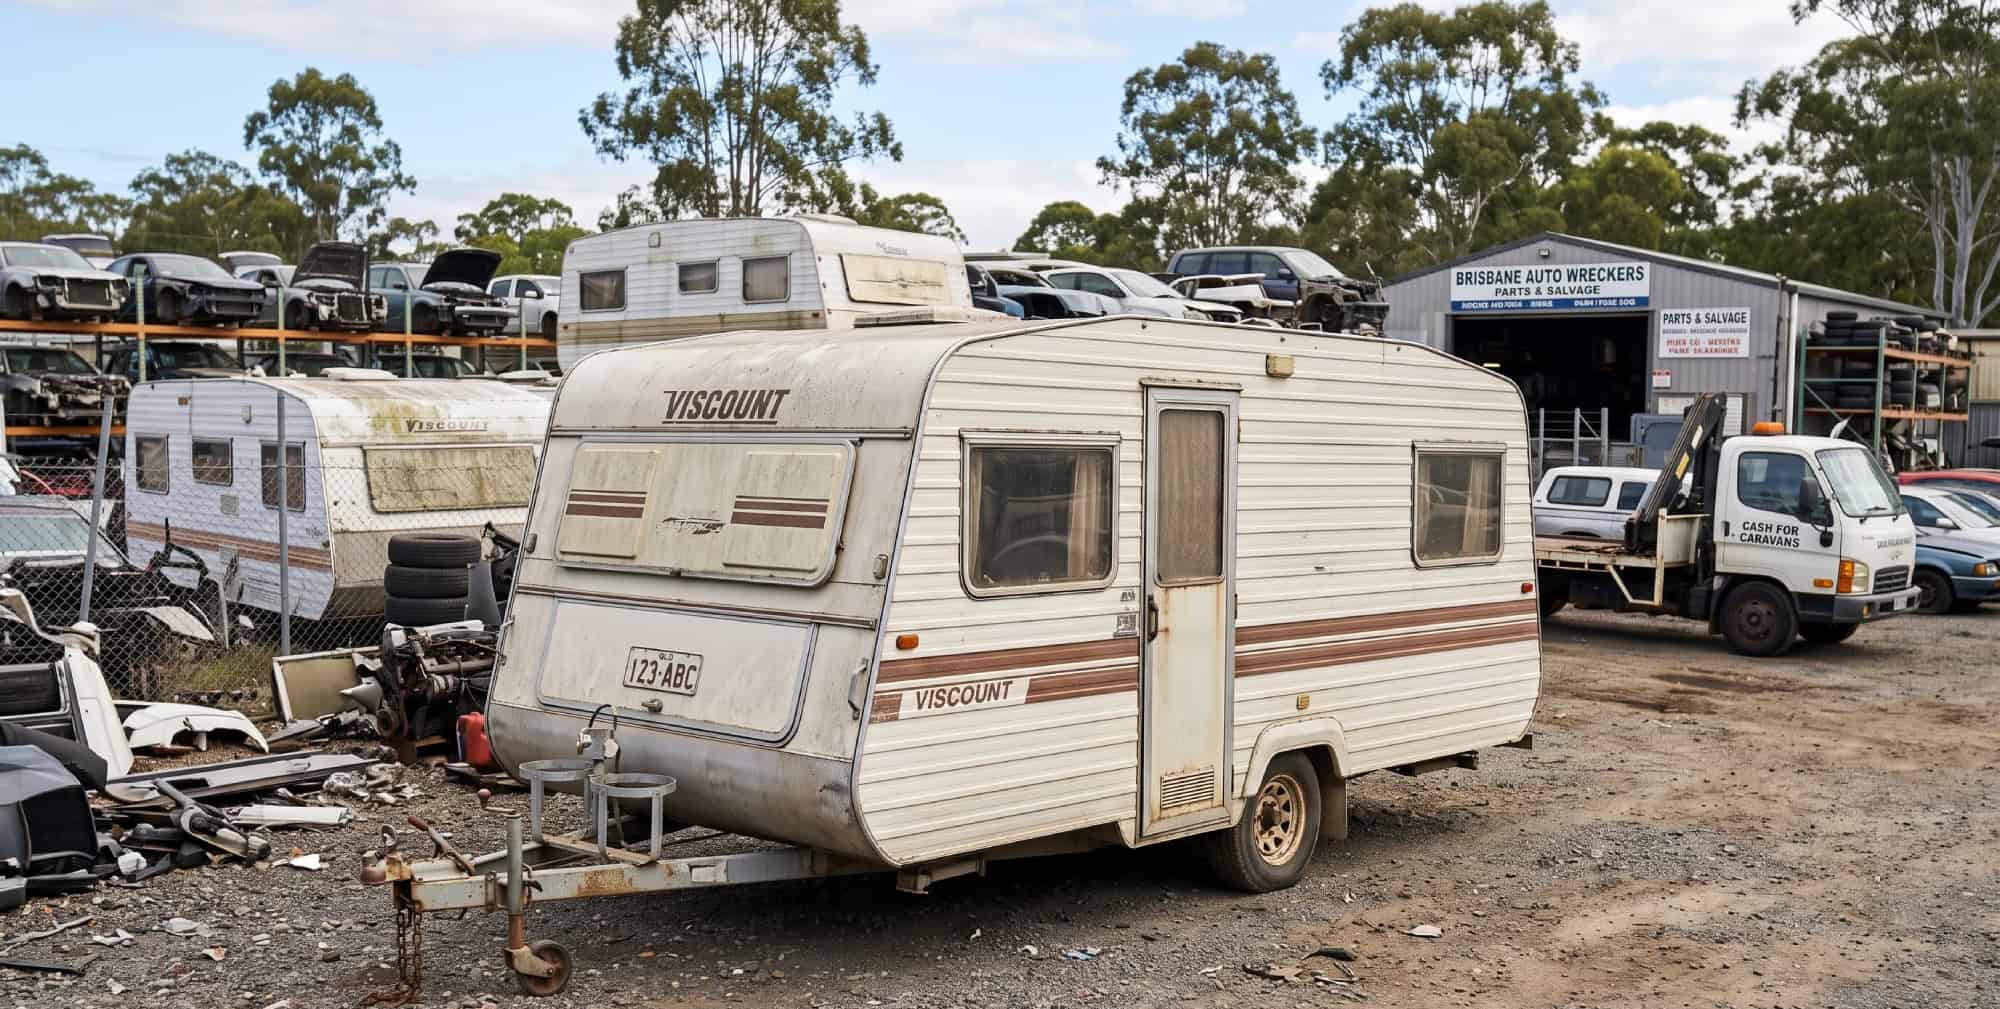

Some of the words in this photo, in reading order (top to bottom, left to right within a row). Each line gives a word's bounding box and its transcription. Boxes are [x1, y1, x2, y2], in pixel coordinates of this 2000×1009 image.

[1456, 270, 1521, 286] BRISBANE
[1526, 269, 1562, 284] AUTO
[1566, 265, 1645, 283] WRECKERS
[1495, 287, 1531, 297] PARTS
[1535, 286, 1543, 296] &
[1547, 285, 1601, 296] SALVAGE
[1663, 313, 1692, 324] PARTS
[1695, 313, 1701, 324] &
[1705, 312, 1747, 324] SALVAGE
[664, 389, 791, 420] VISCOUNT
[1742, 521, 1773, 533] CASH
[1776, 524, 1799, 536] FOR
[1740, 532, 1801, 548] CARAVANS
[659, 652, 674, 661] QLD
[916, 680, 1013, 710] VISCOUNT
